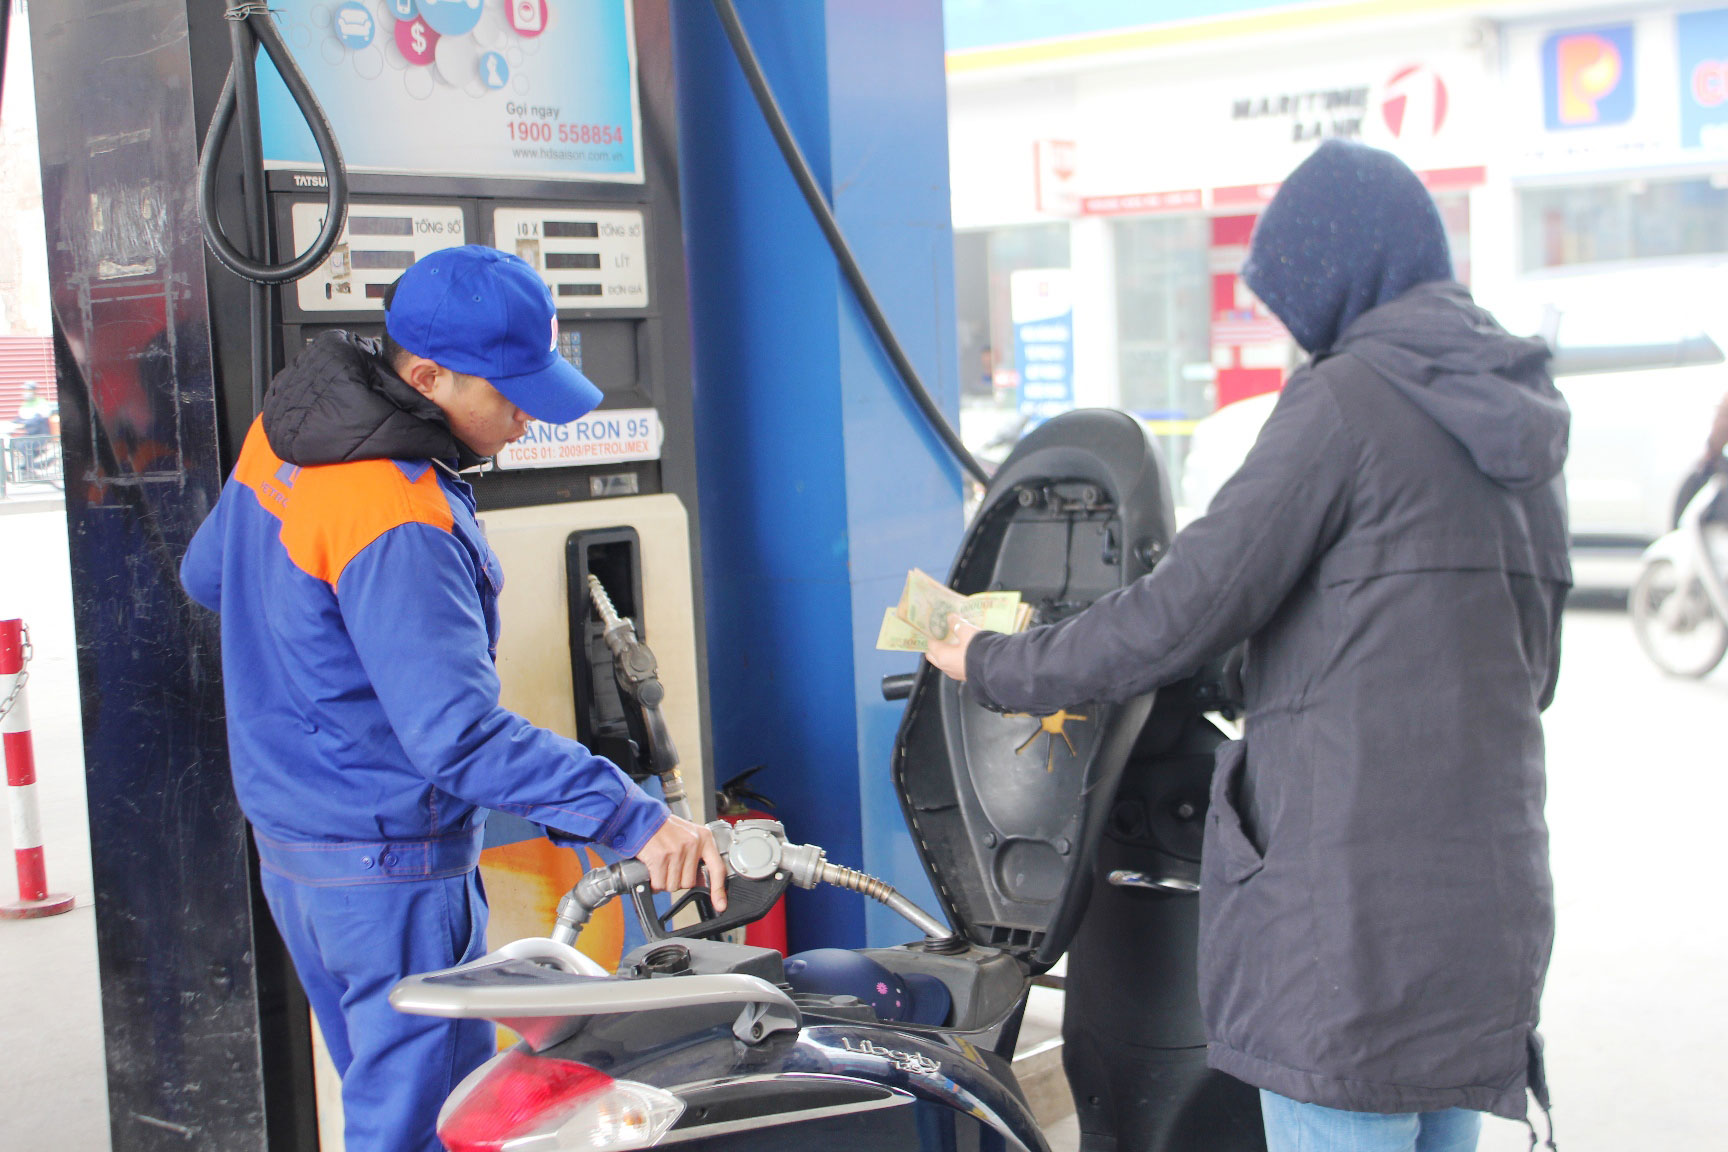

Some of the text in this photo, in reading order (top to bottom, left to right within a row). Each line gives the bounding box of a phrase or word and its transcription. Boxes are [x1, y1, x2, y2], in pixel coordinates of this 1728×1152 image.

[506, 102, 560, 120] Gọi ngay
[507, 121, 624, 145] 1900 558854
[293, 175, 329, 188] TATSU
[576, 420, 620, 441] RON
[627, 418, 650, 438] 95
[509, 447, 538, 461] TCCS
